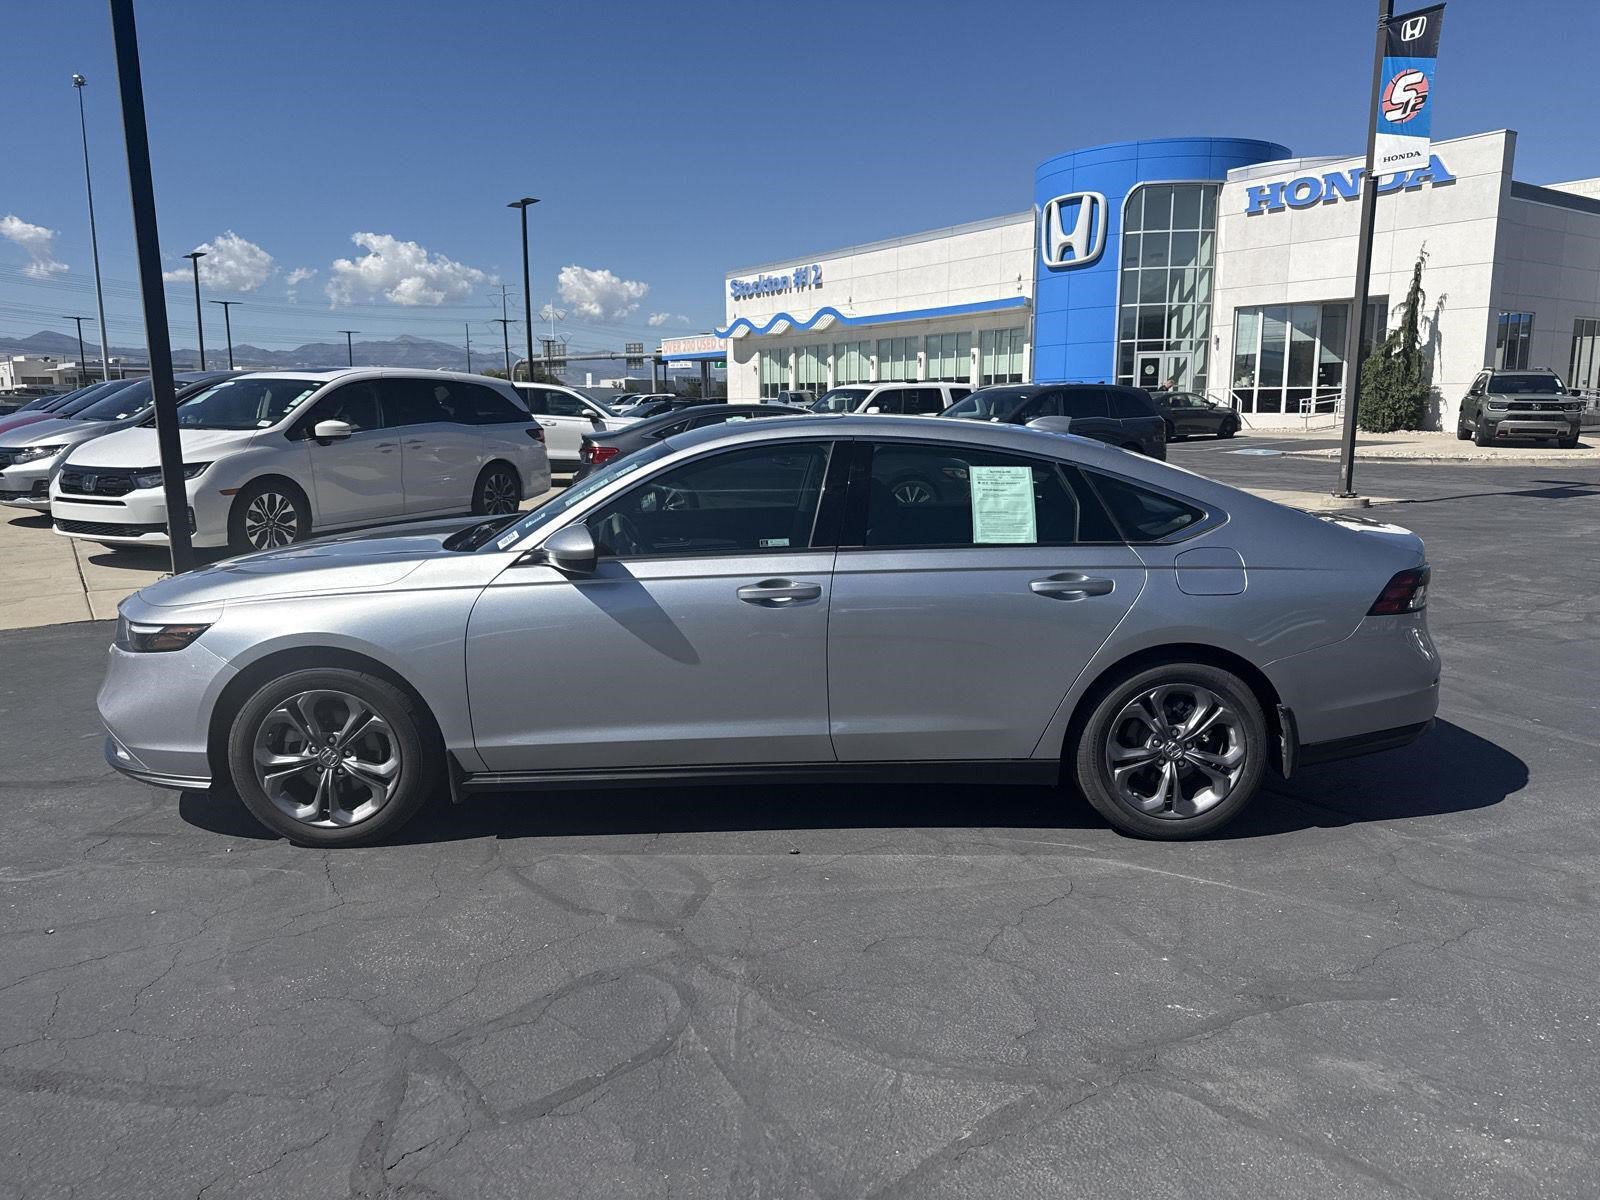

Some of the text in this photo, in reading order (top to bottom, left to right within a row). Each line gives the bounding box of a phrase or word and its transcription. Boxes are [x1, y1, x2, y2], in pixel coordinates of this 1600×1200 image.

[1383, 150, 1422, 163] HONDA
[730, 264, 823, 299] Stockton #12
[663, 340, 682, 354] OVER
[697, 337, 716, 351] USED
